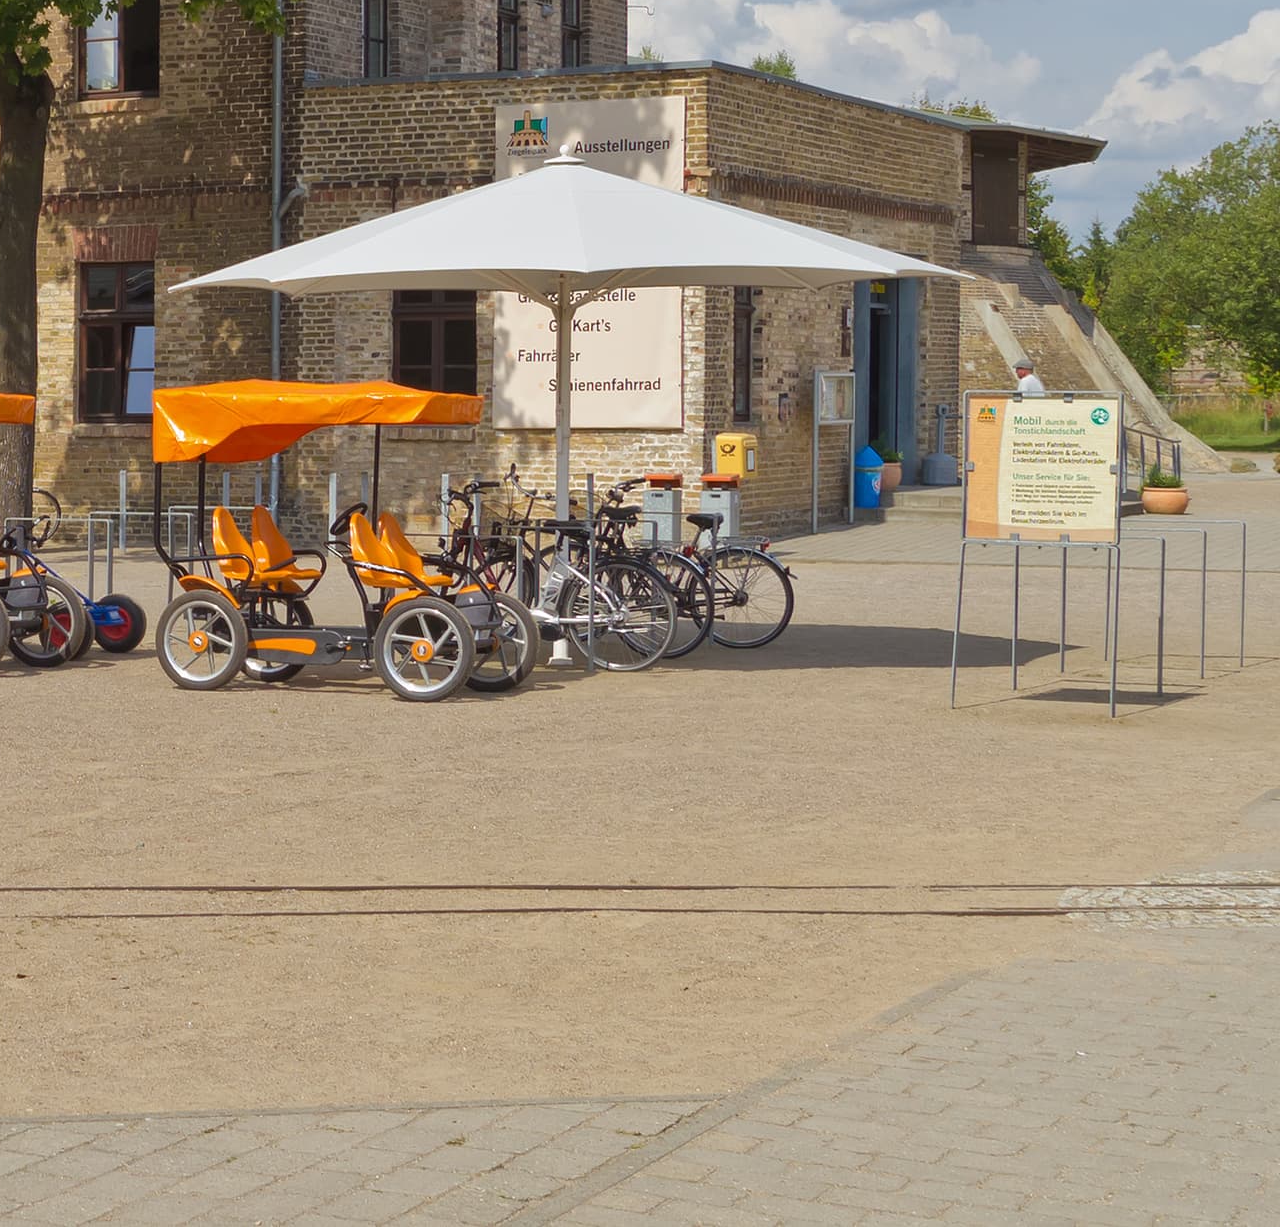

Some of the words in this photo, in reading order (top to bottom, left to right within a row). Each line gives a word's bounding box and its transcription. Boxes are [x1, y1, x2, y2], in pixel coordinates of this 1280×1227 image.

[574, 138, 671, 154] Ausstellungen
[518, 349, 581, 362] Fahrräer
[1013, 416, 1041, 425] Mobil
[1013, 427, 1086, 435] Tonstichlandschaft
